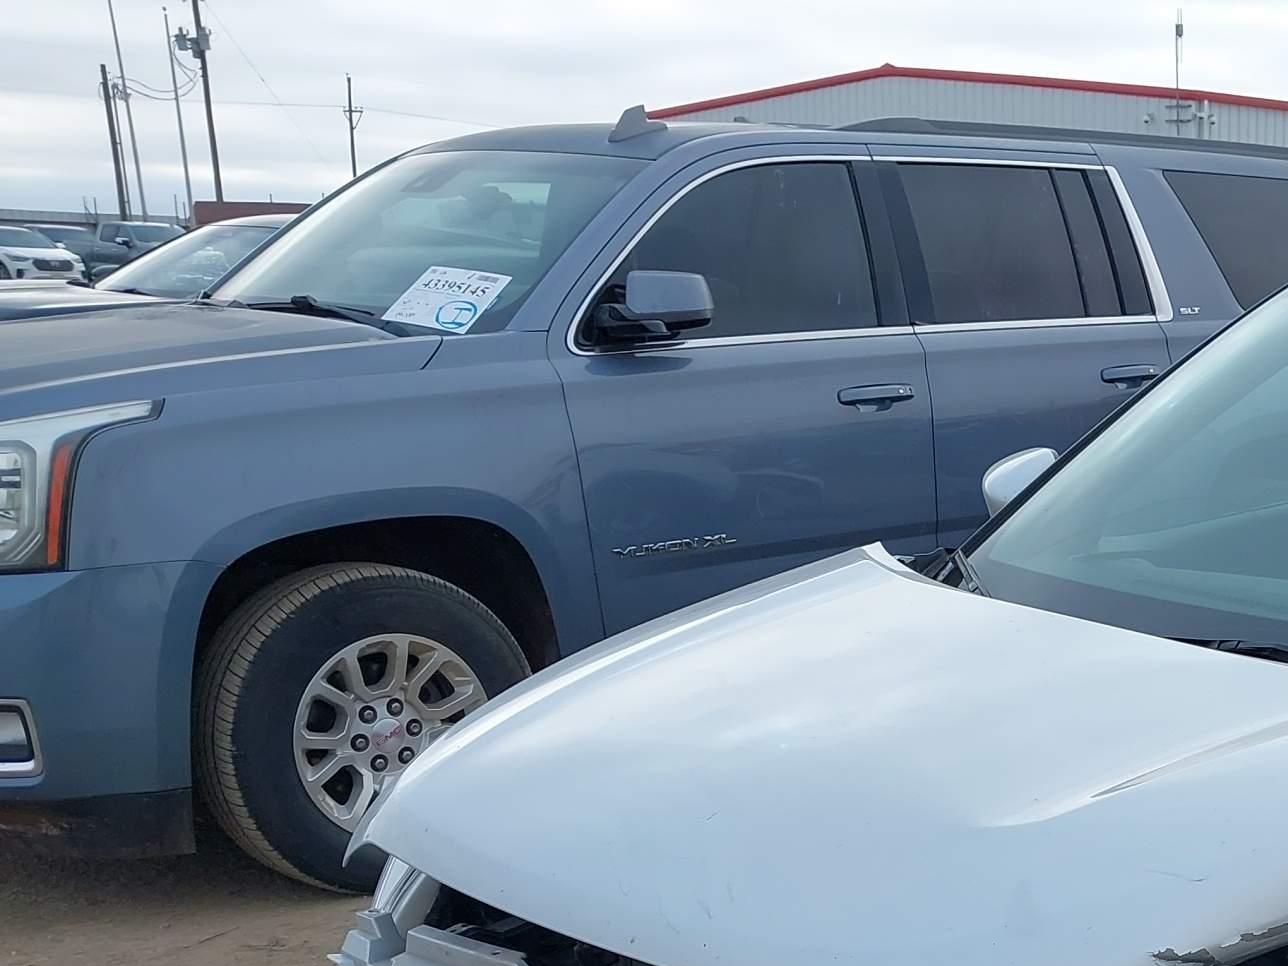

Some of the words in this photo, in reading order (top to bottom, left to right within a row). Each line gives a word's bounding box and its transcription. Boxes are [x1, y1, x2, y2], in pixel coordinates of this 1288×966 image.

[422, 278, 491, 298] 43395145
[1180, 306, 1201, 315] SLT
[612, 538, 700, 559] YUKON
[703, 534, 737, 548] XL
[376, 726, 401, 746] GMC
